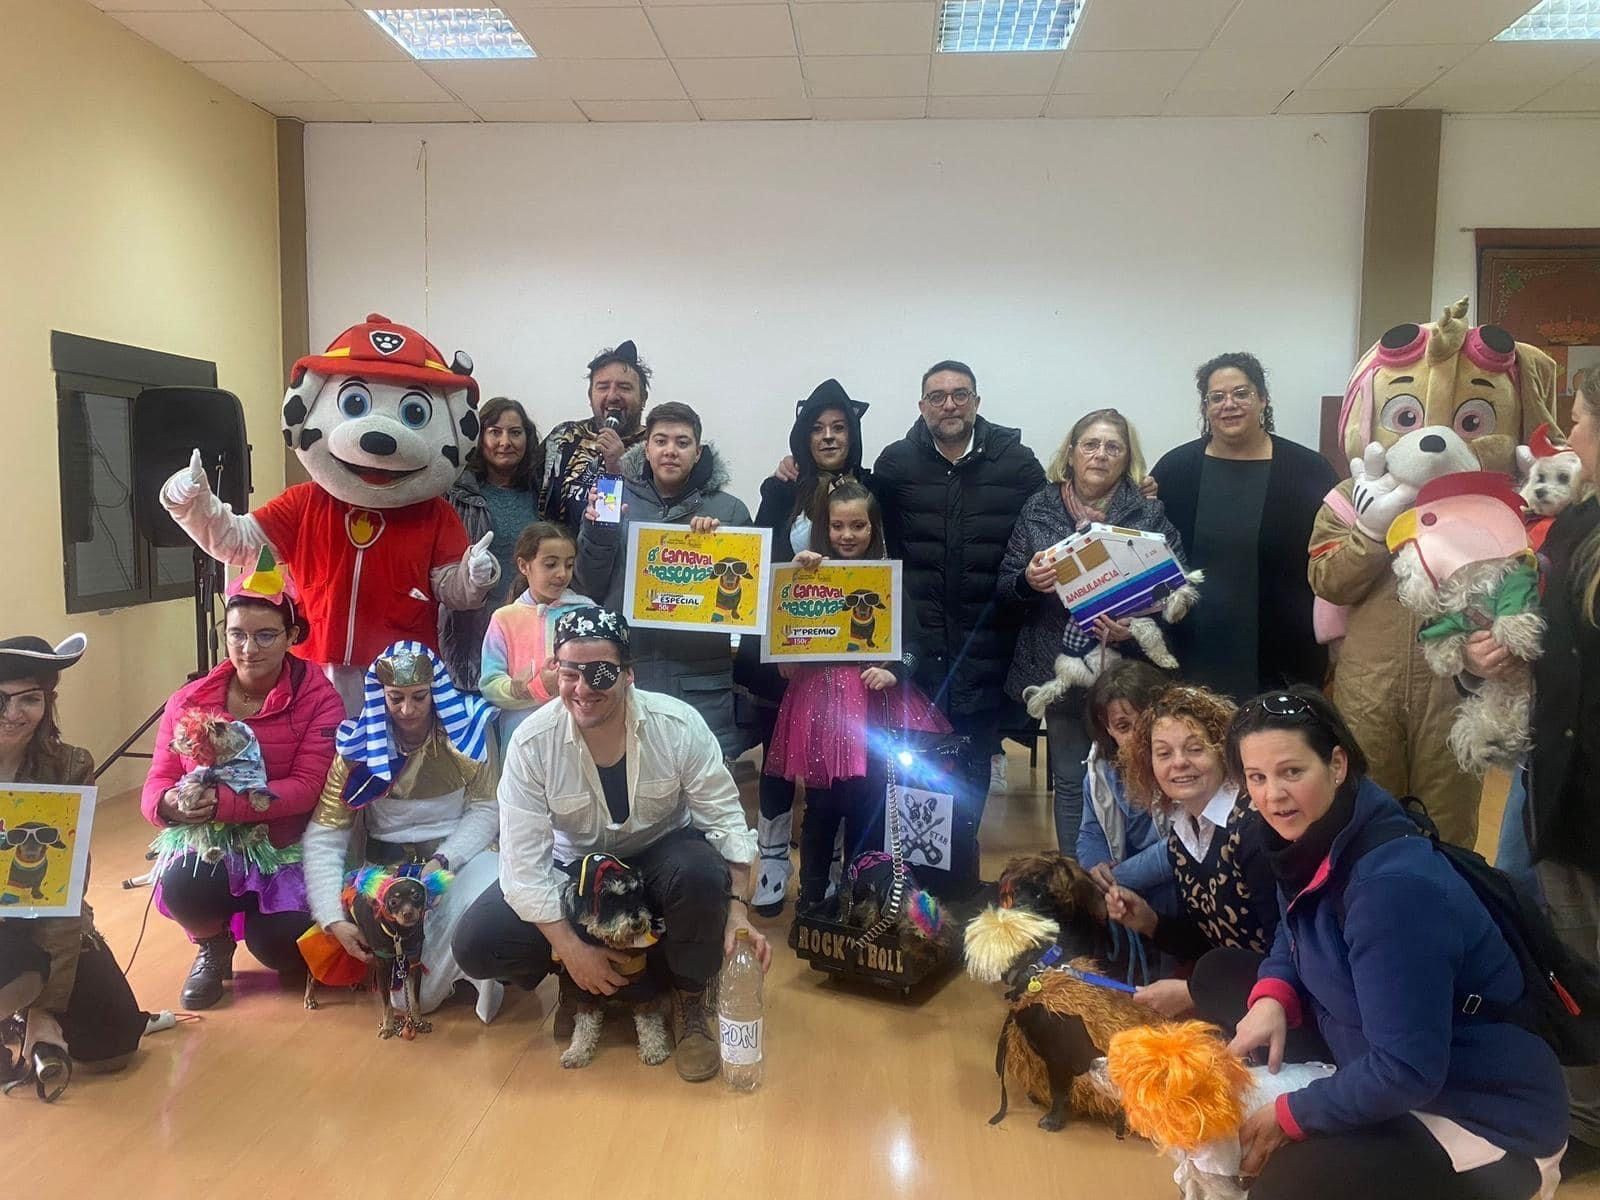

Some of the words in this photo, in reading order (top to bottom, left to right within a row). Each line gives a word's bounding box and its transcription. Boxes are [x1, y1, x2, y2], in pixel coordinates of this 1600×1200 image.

[661, 548, 713, 565] Carnaval
[793, 584, 845, 599] Carnaval
[1065, 569, 1120, 604] AMBULANCIA
[660, 596, 699, 605] ESPECIAL
[802, 628, 836, 636] PREMIO
[929, 831, 949, 846] STAR
[798, 926, 846, 961] ROCK
[867, 943, 904, 974] ROLL
[720, 1020, 758, 1049] RON
